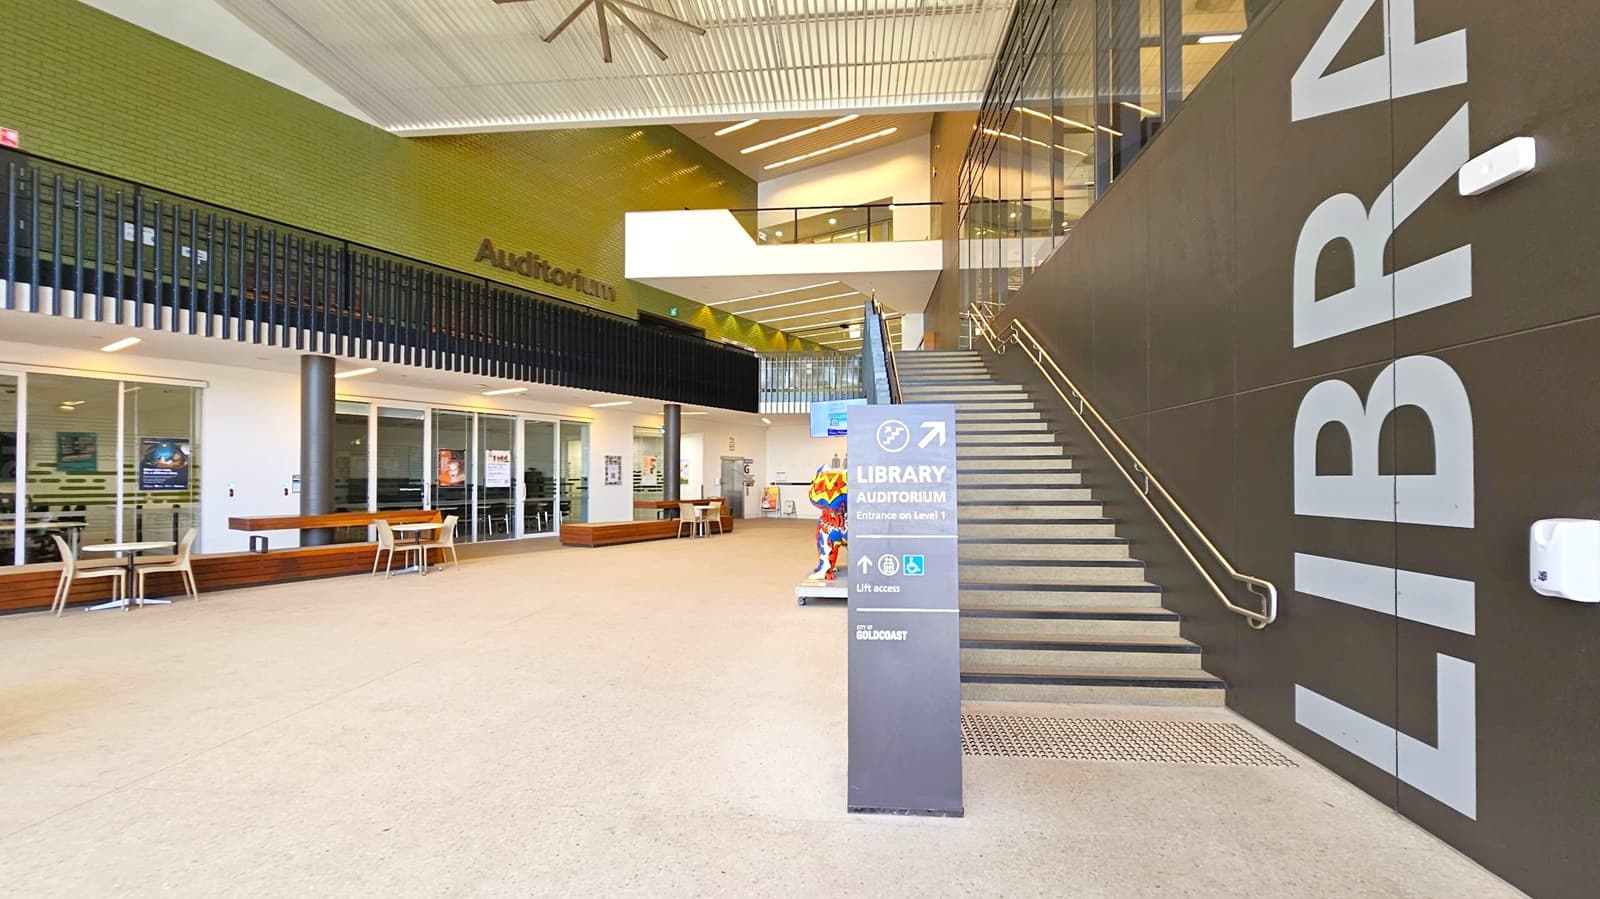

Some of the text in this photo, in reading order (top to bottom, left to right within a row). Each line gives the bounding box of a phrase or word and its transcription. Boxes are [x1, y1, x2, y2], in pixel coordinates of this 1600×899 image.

[475, 238, 617, 302] Auditorium
[856, 465, 947, 484] LIBRARY
[856, 491, 947, 503] AUDITORIUM
[856, 511, 897, 520] Entrance
[914, 511, 938, 520] Level
[940, 511, 946, 520] 1
[856, 583, 901, 593] Lift access
[856, 630, 908, 641] GOLDCOAST
